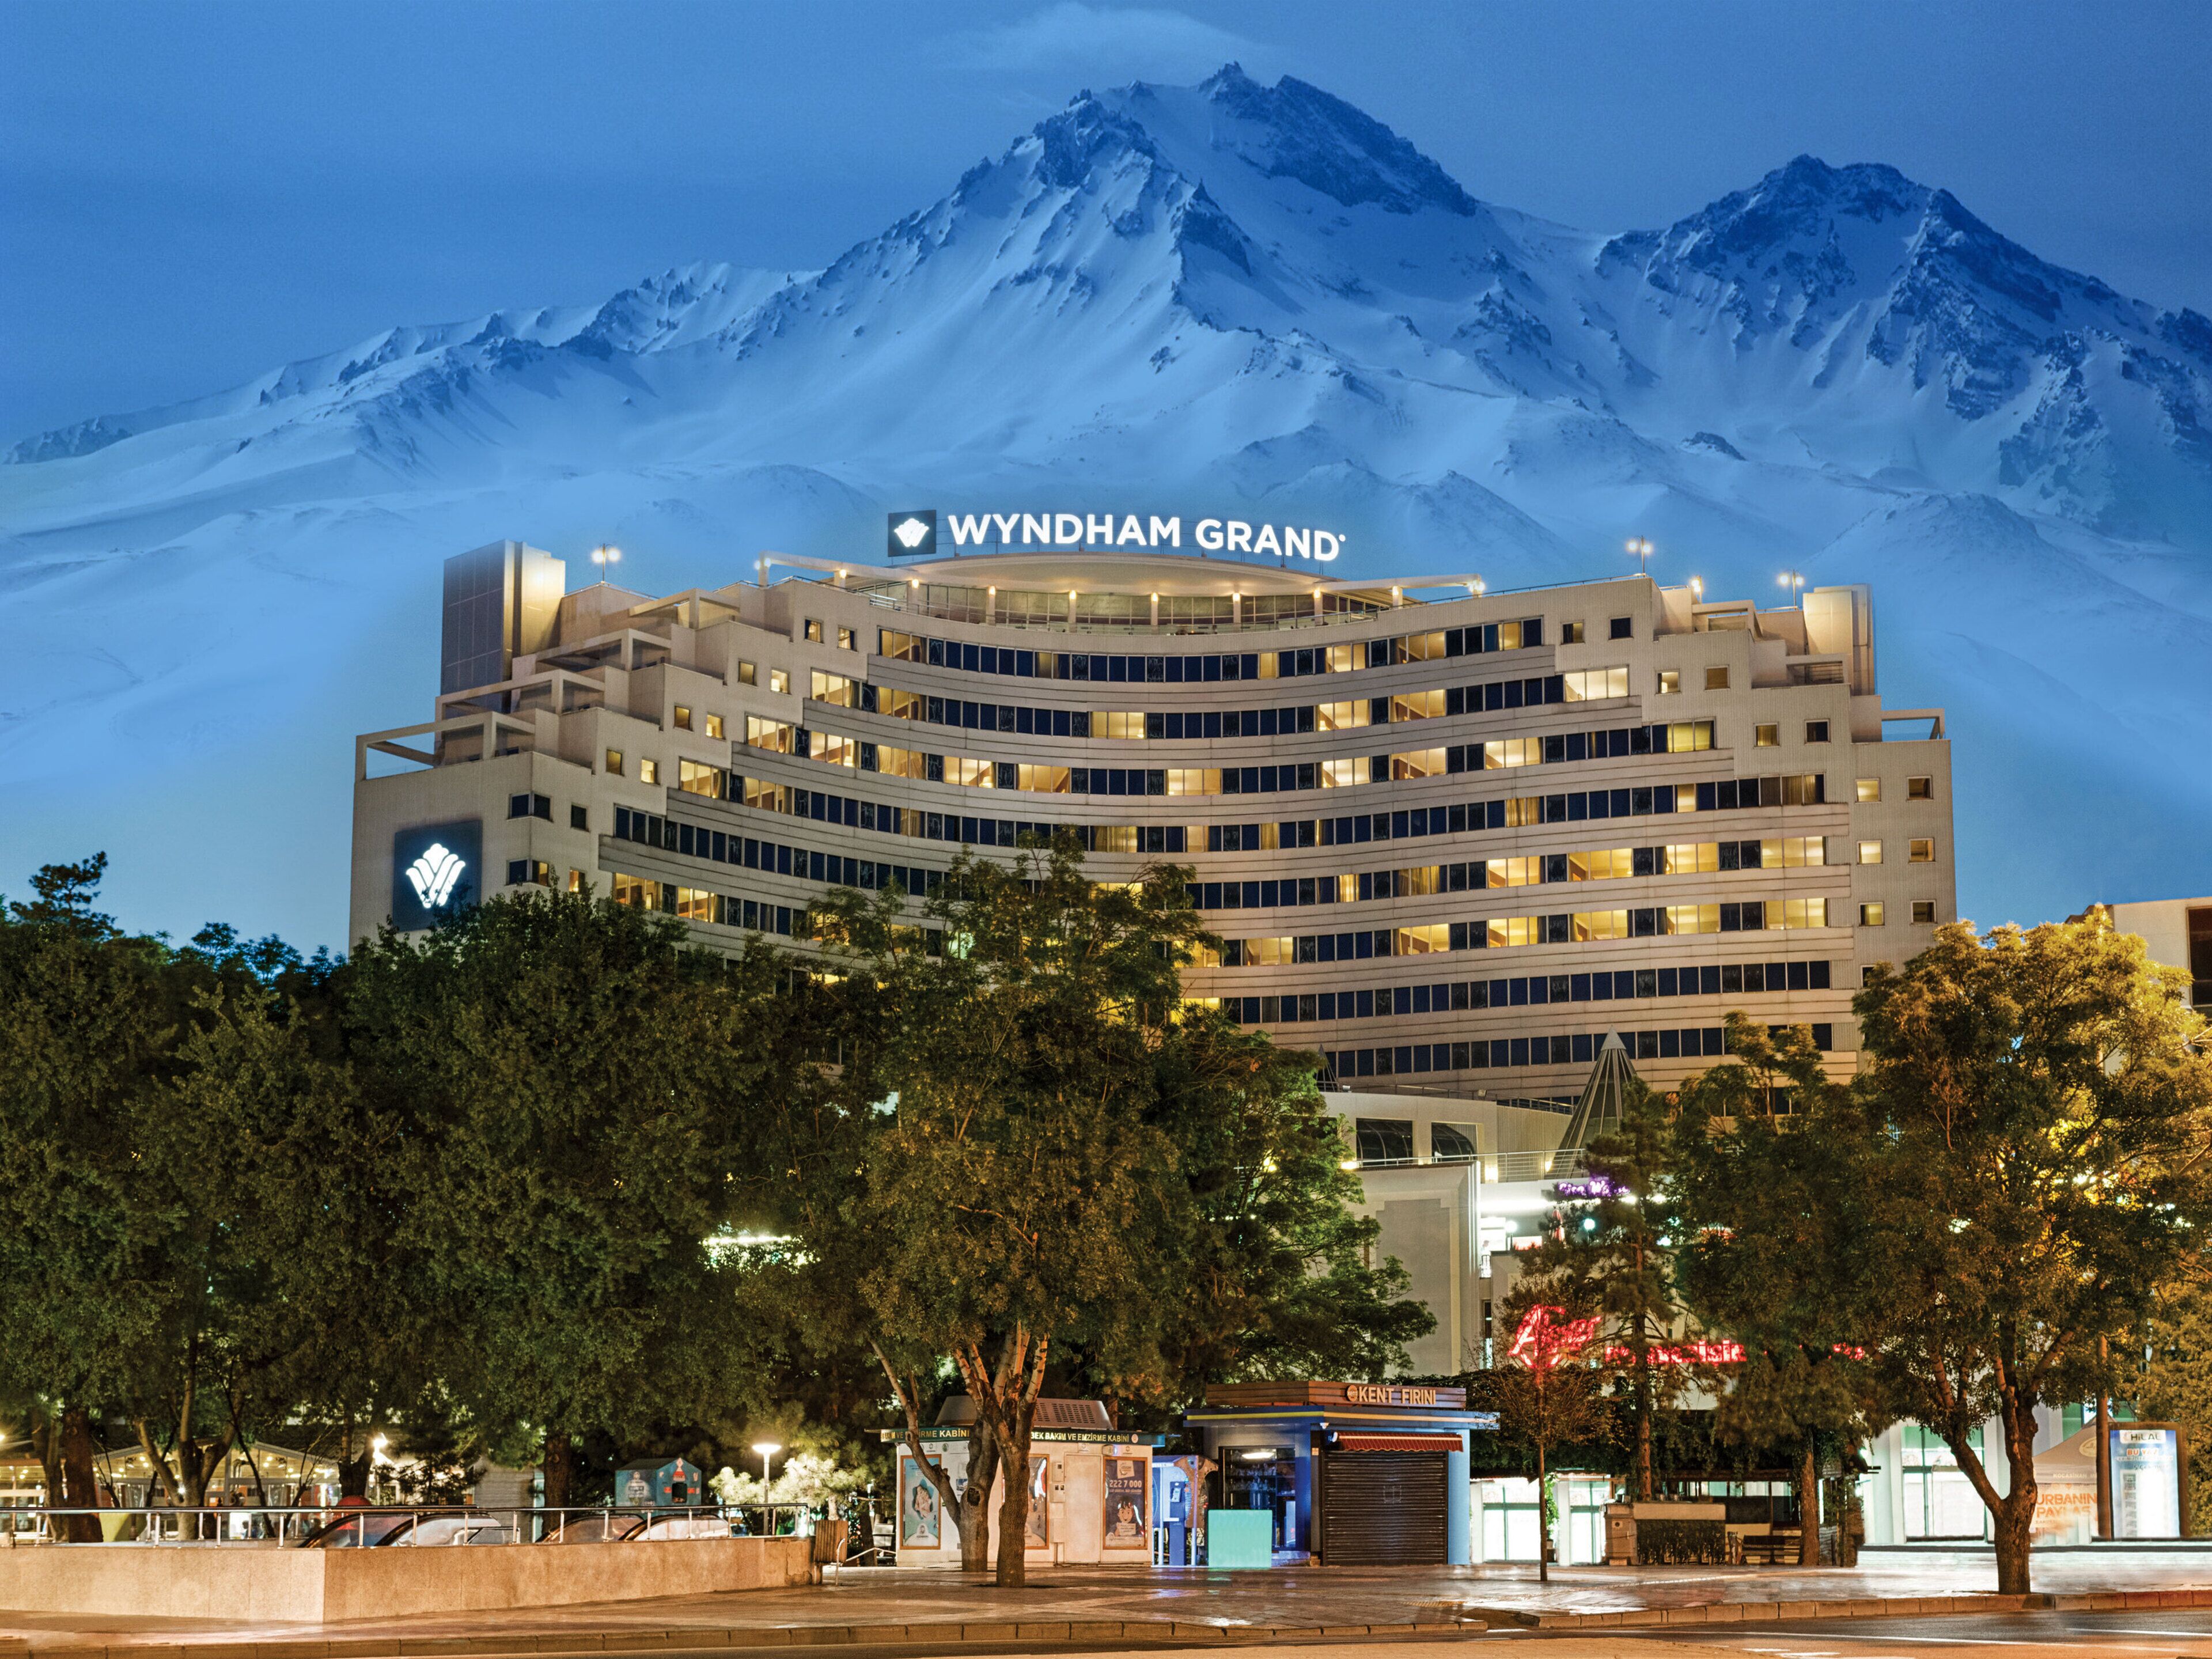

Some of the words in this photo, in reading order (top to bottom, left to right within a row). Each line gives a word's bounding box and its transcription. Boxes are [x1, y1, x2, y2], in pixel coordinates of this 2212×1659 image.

[948, 514, 1180, 547] WYNDHAM
[1195, 518, 1340, 561] GRAND
[1359, 1386, 1394, 1403] KENT
[1400, 1389, 1436, 1404] FIRINI
[1045, 1433, 1066, 1441] BAKIM
[1078, 1432, 1107, 1441] EMZİRME
[1108, 1434, 1129, 1442] KABİNİ
[1123, 1480, 1128, 1488] 7
[1129, 1480, 1142, 1488] 000
